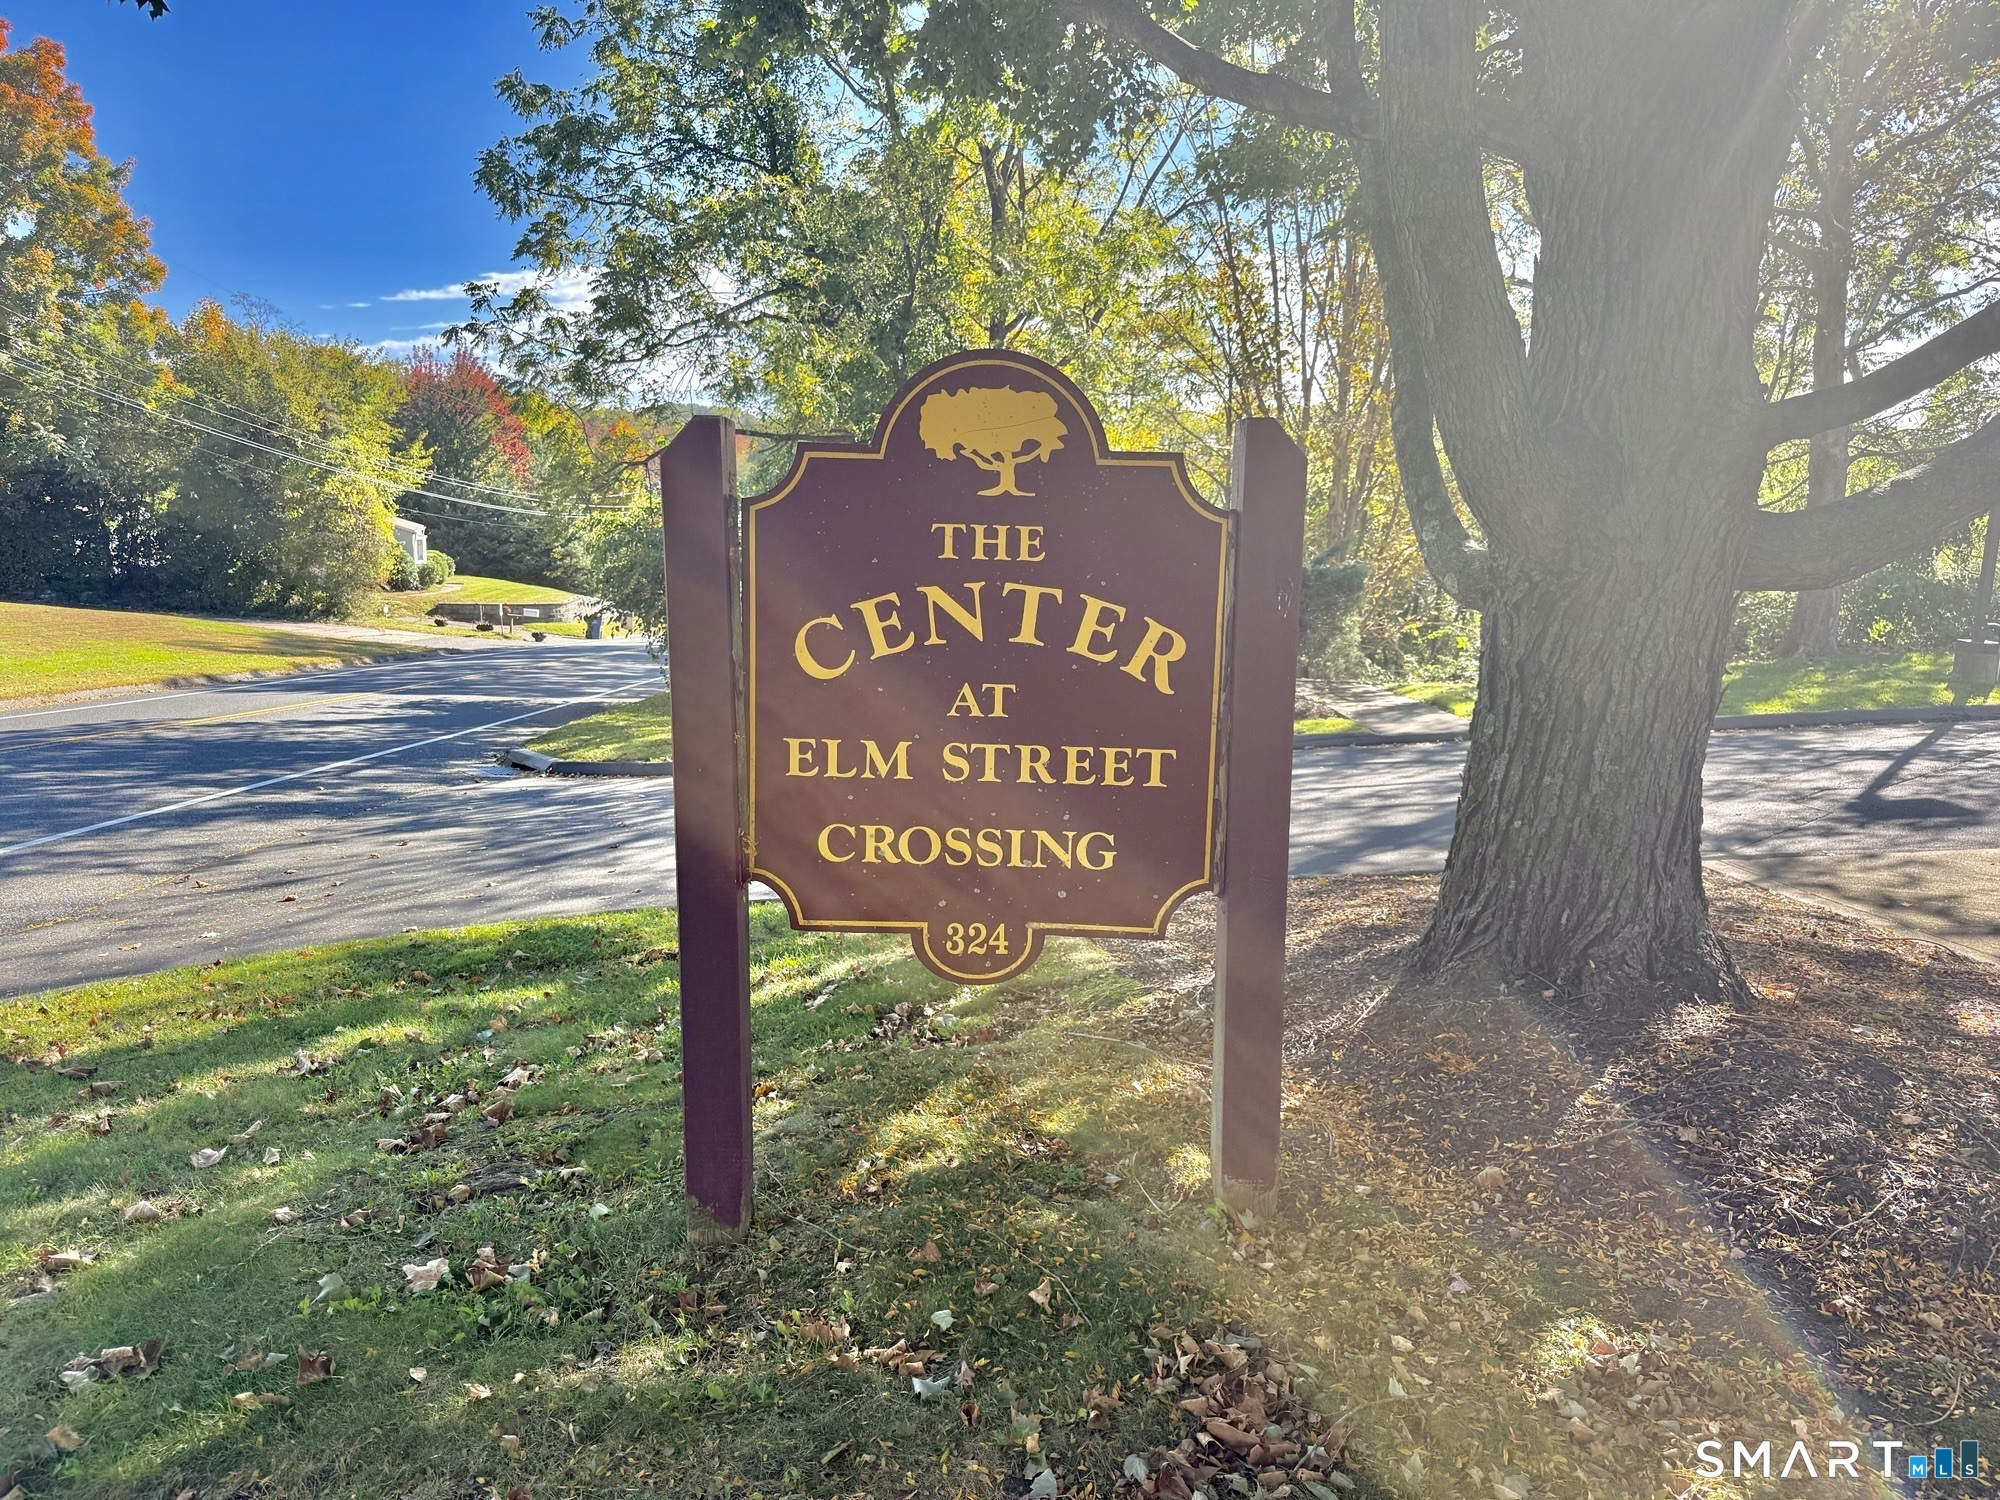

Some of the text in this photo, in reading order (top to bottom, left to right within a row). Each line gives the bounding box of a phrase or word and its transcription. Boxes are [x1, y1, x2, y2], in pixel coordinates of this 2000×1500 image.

[931, 523, 1045, 561] THE
[794, 581, 1187, 695] CENTER
[947, 682, 1016, 718] AT
[784, 737, 1177, 788] ELM STREET
[817, 823, 1117, 871] CROSSING
[945, 922, 1009, 955] 324
